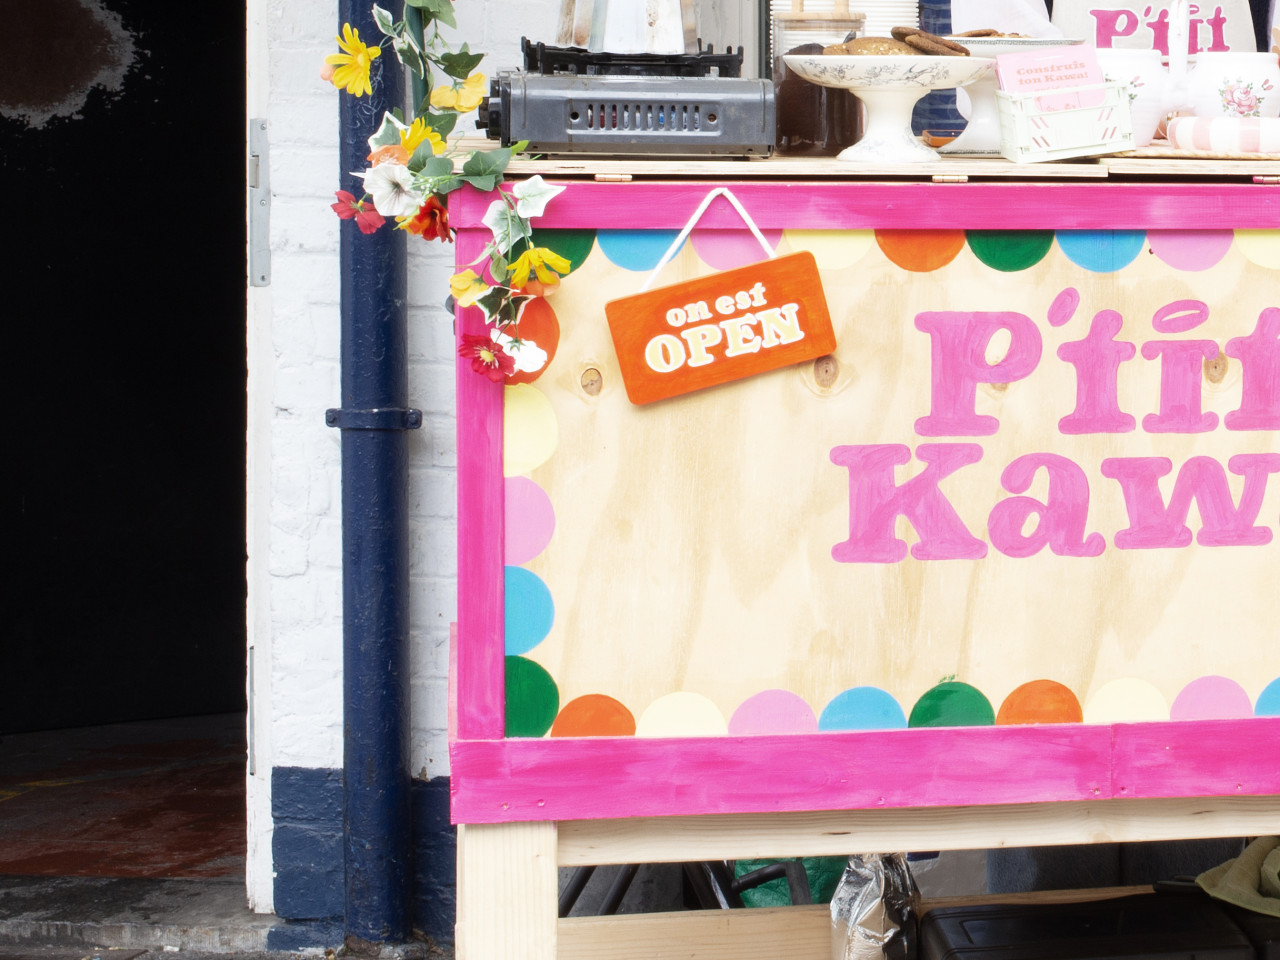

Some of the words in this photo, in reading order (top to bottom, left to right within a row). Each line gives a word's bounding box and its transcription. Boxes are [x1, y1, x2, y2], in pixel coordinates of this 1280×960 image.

[1016, 61, 1086, 76] Construis
[1017, 76, 1042, 85] ton
[1044, 71, 1089, 83] Kawa!
[665, 300, 711, 330] on
[714, 282, 769, 319] est
[644, 303, 806, 374] OPEN
